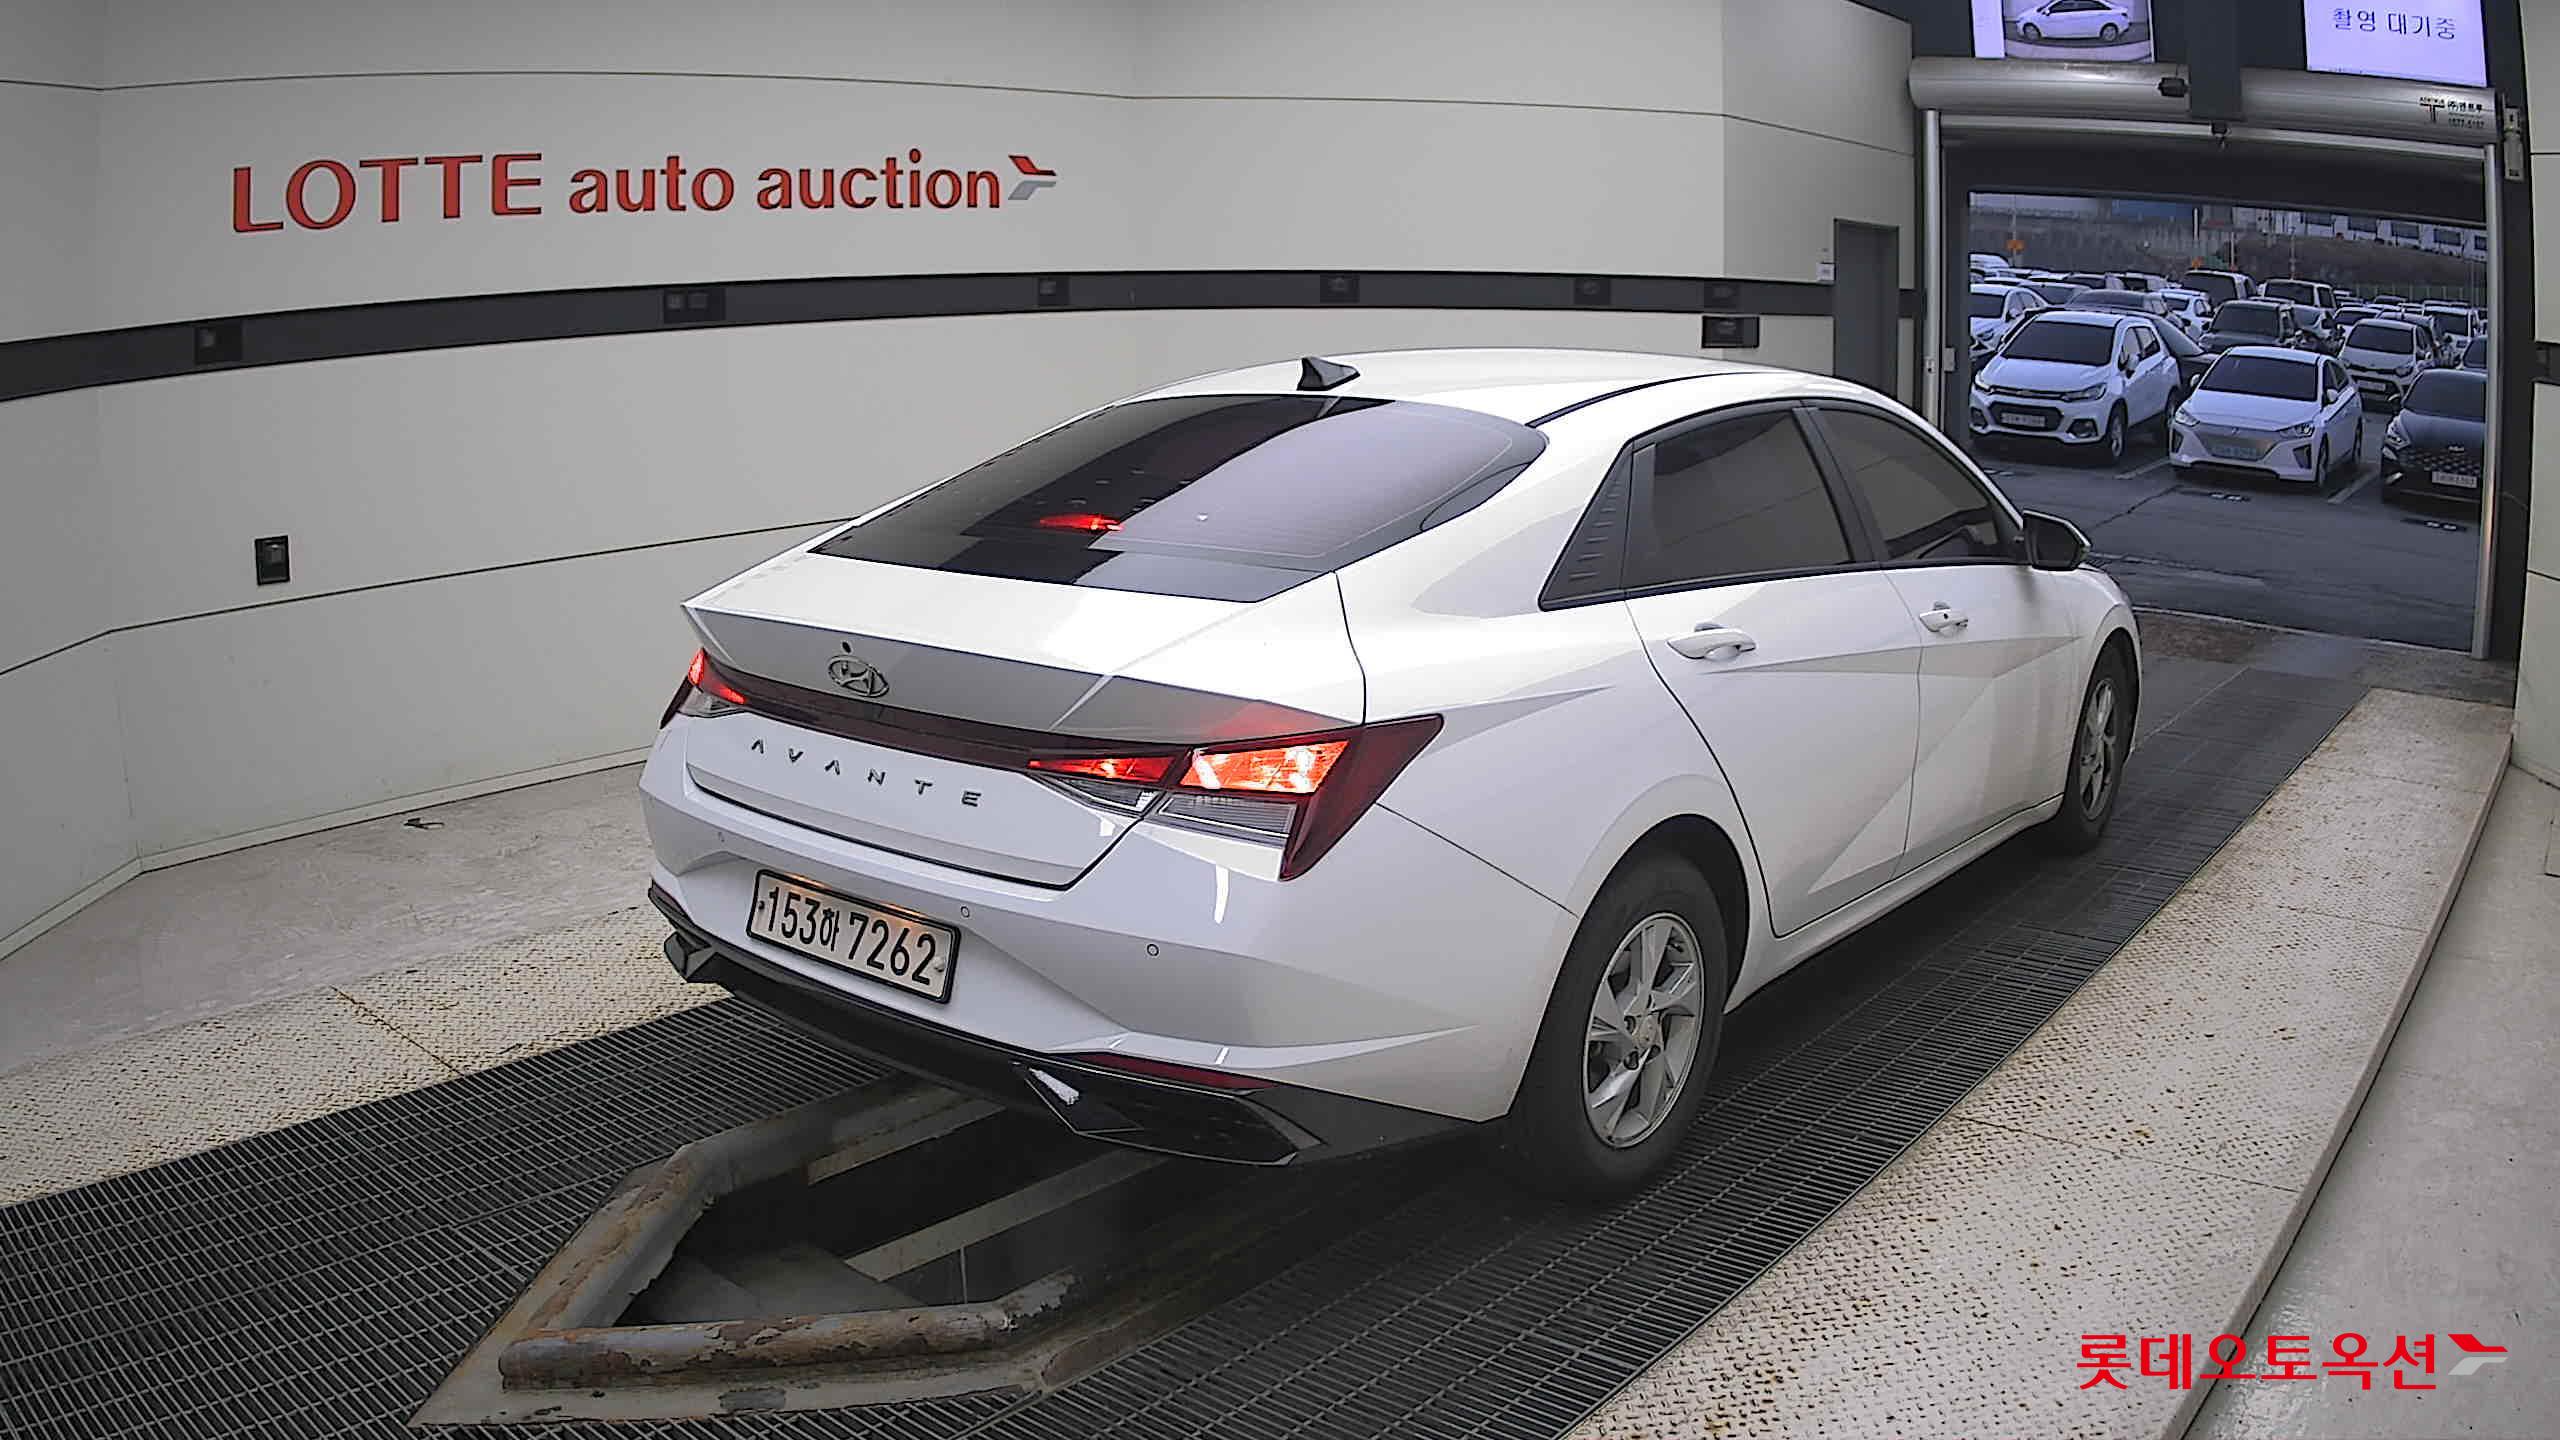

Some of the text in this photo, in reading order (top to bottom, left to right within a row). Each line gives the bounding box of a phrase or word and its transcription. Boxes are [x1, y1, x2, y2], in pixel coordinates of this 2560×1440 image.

[2333, 8, 2456, 41] 촬영 대기중
[233, 149, 1002, 233] LOTTE auto auction
[751, 738, 982, 808] AVANTE
[767, 886, 937, 986] 153하 7262
